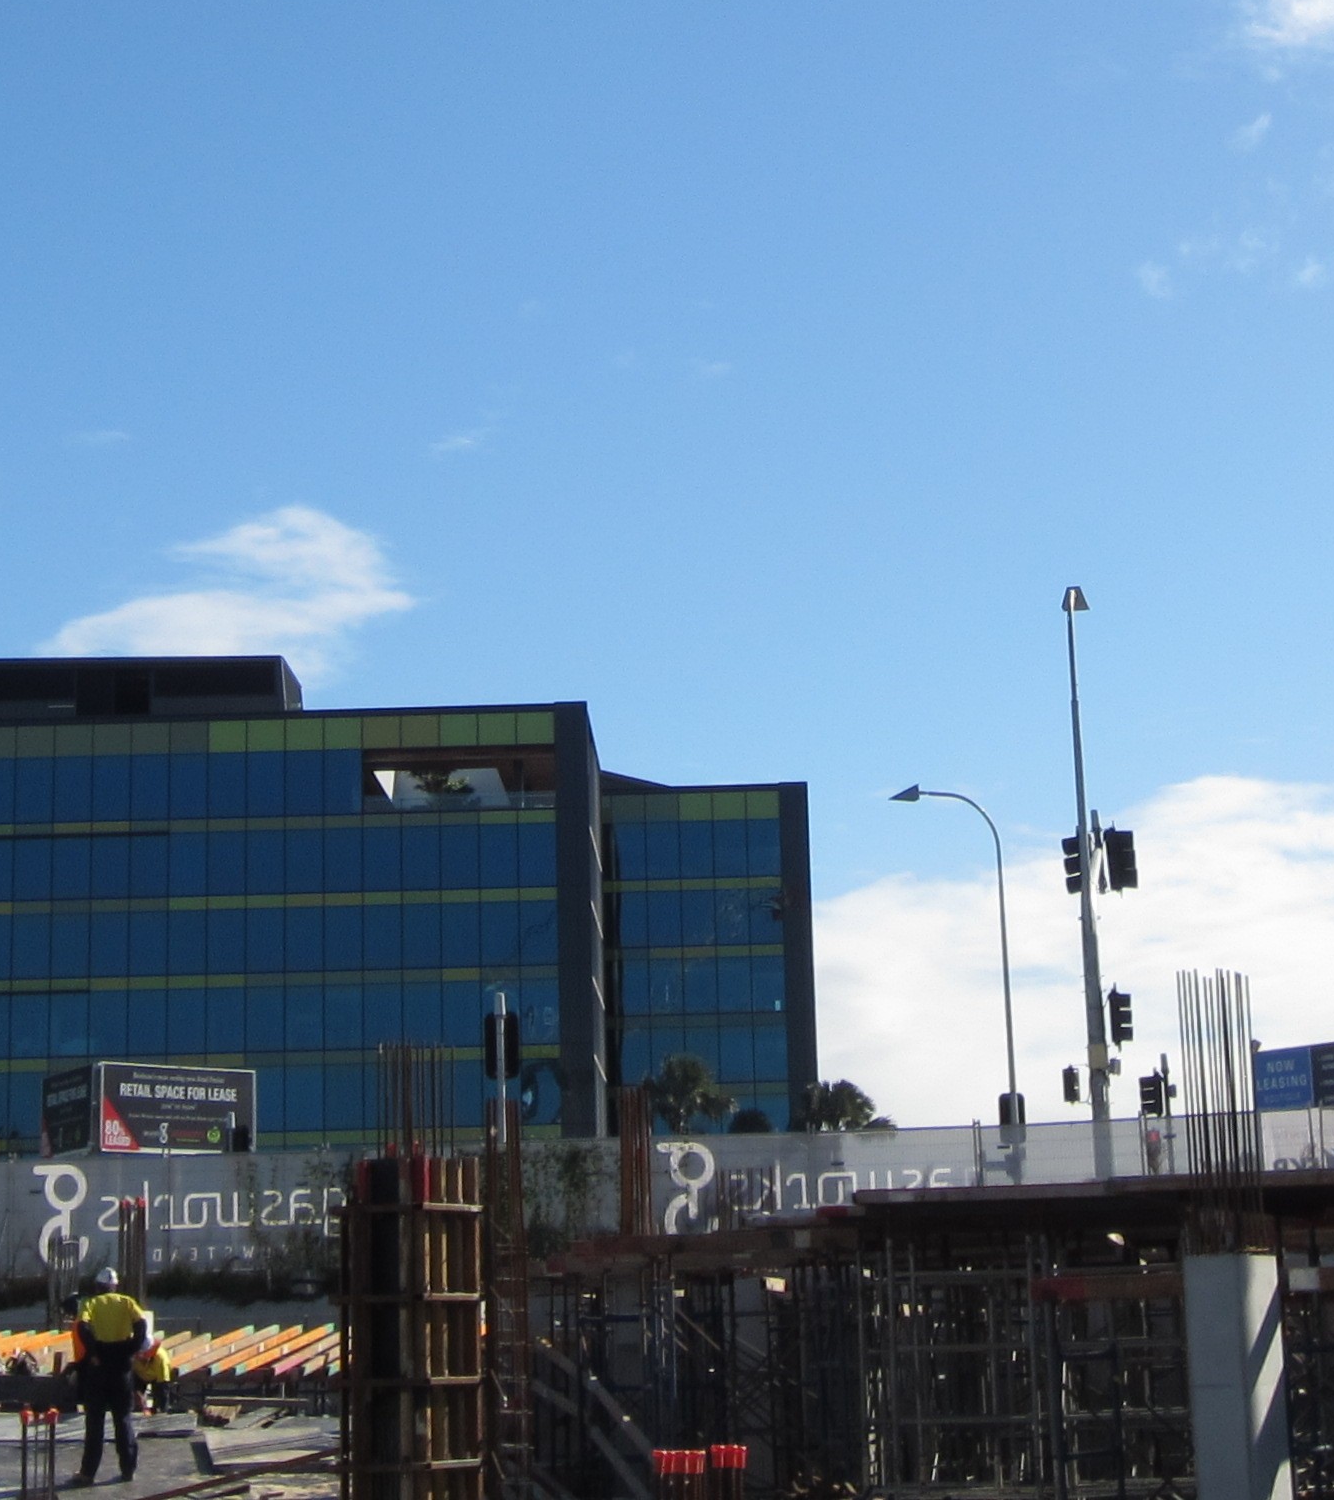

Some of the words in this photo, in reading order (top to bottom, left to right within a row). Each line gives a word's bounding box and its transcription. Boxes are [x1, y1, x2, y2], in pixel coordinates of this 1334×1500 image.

[1267, 1059, 1296, 1073] NOW
[1256, 1073, 1308, 1091] LEASING
[120, 1082, 152, 1098] RETAIL
[154, 1084, 186, 1100] SPACE
[187, 1086, 206, 1101] FOR
[208, 1087, 238, 1102] LEASE
